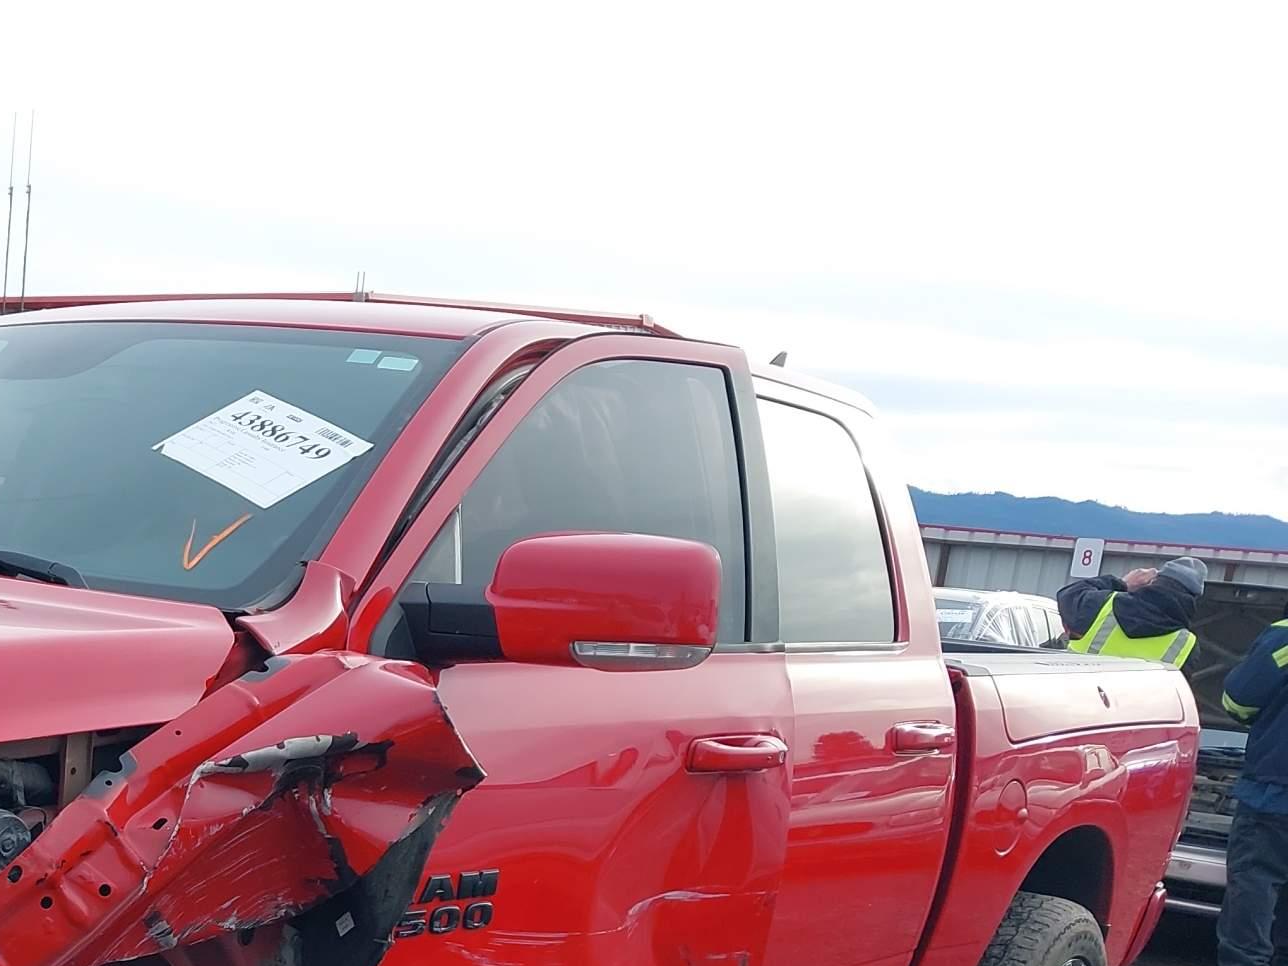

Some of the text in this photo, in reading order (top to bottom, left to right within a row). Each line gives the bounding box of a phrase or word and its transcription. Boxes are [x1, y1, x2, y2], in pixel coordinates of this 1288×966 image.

[231, 410, 332, 460] 43886749
[1082, 550, 1092, 566] 8
[420, 869, 500, 902] AM
[397, 902, 494, 937] 500
